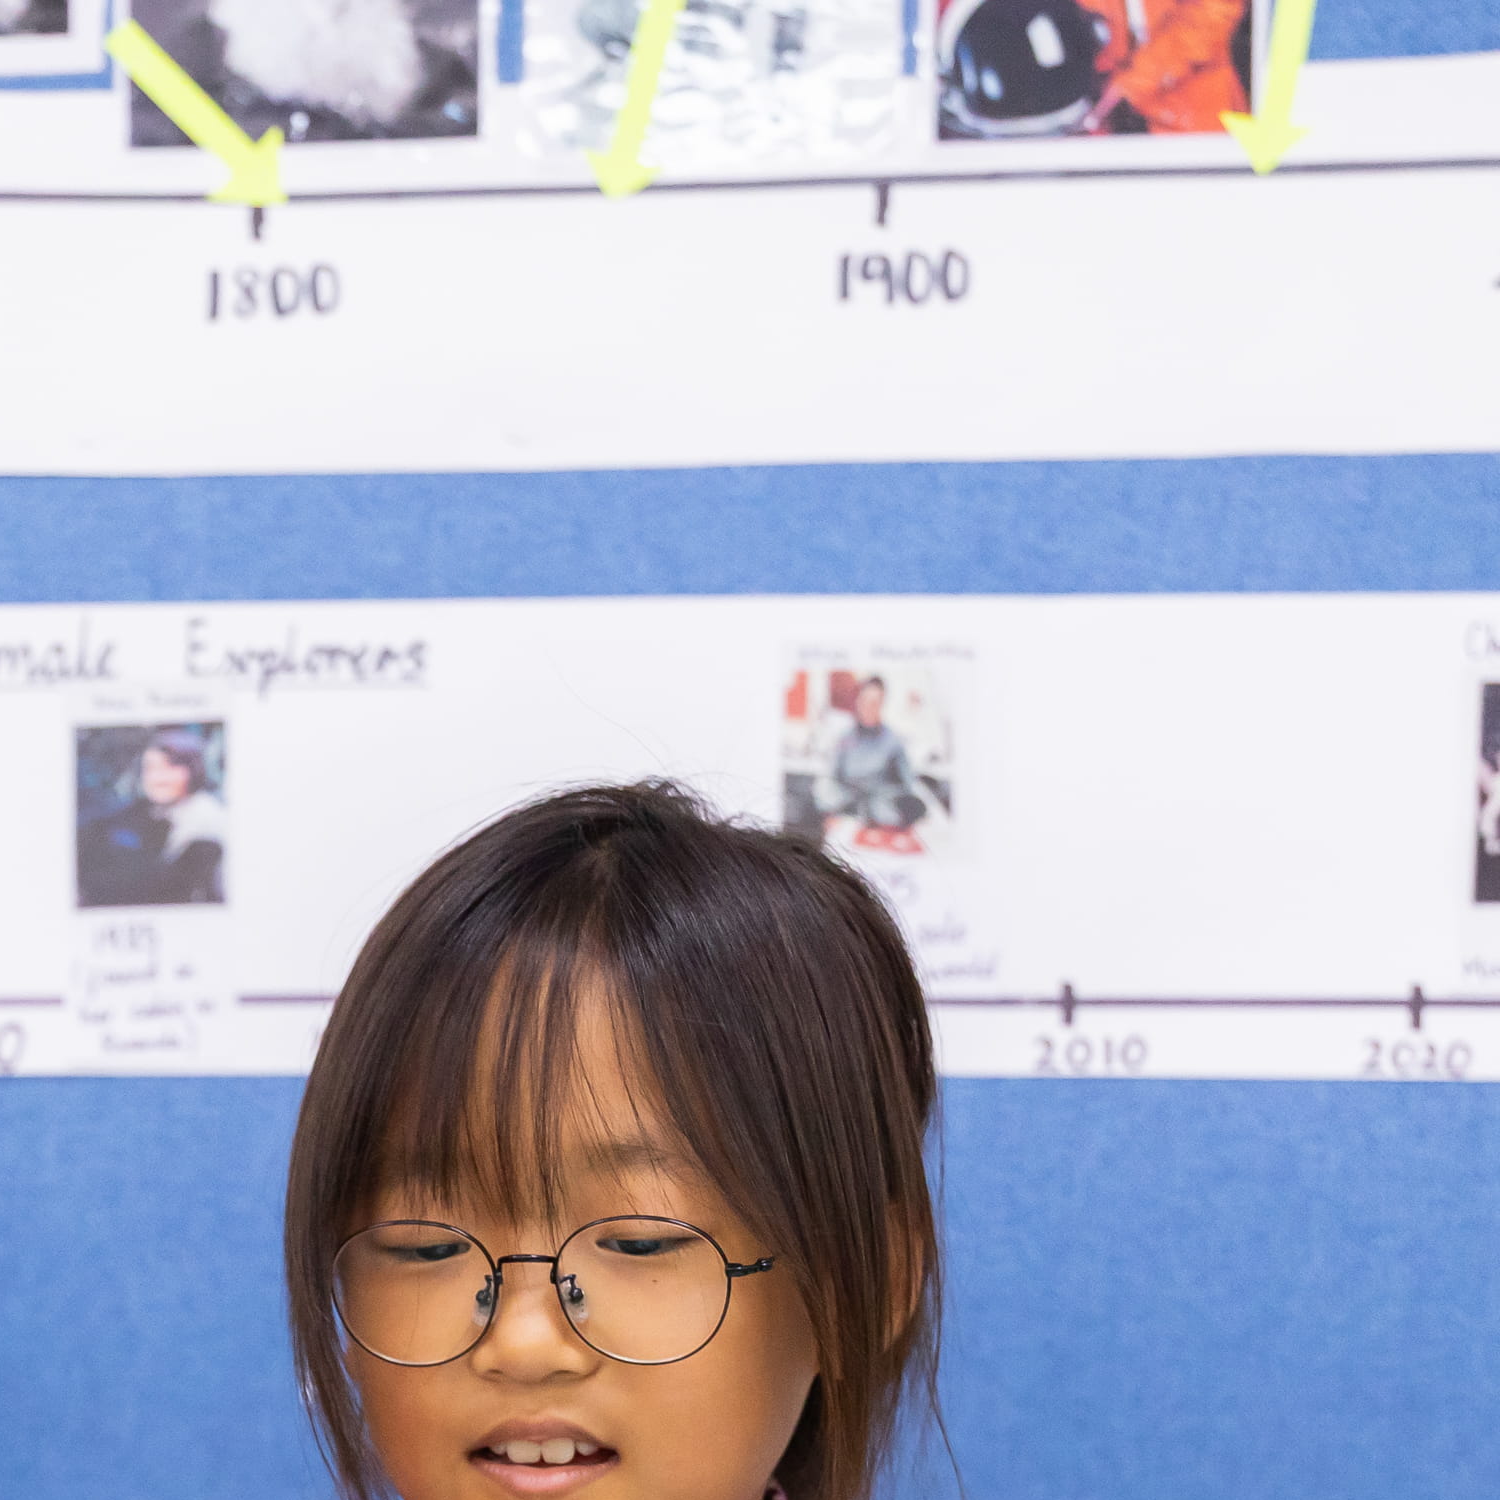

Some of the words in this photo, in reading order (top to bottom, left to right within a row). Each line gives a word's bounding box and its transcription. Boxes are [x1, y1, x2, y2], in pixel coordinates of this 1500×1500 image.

[204, 262, 342, 323] 1800
[836, 248, 971, 305] 1900
[183, 612, 429, 702] Explorers
[1032, 1035, 1150, 1075] 2010
[1362, 1034, 1474, 1078] 2020
